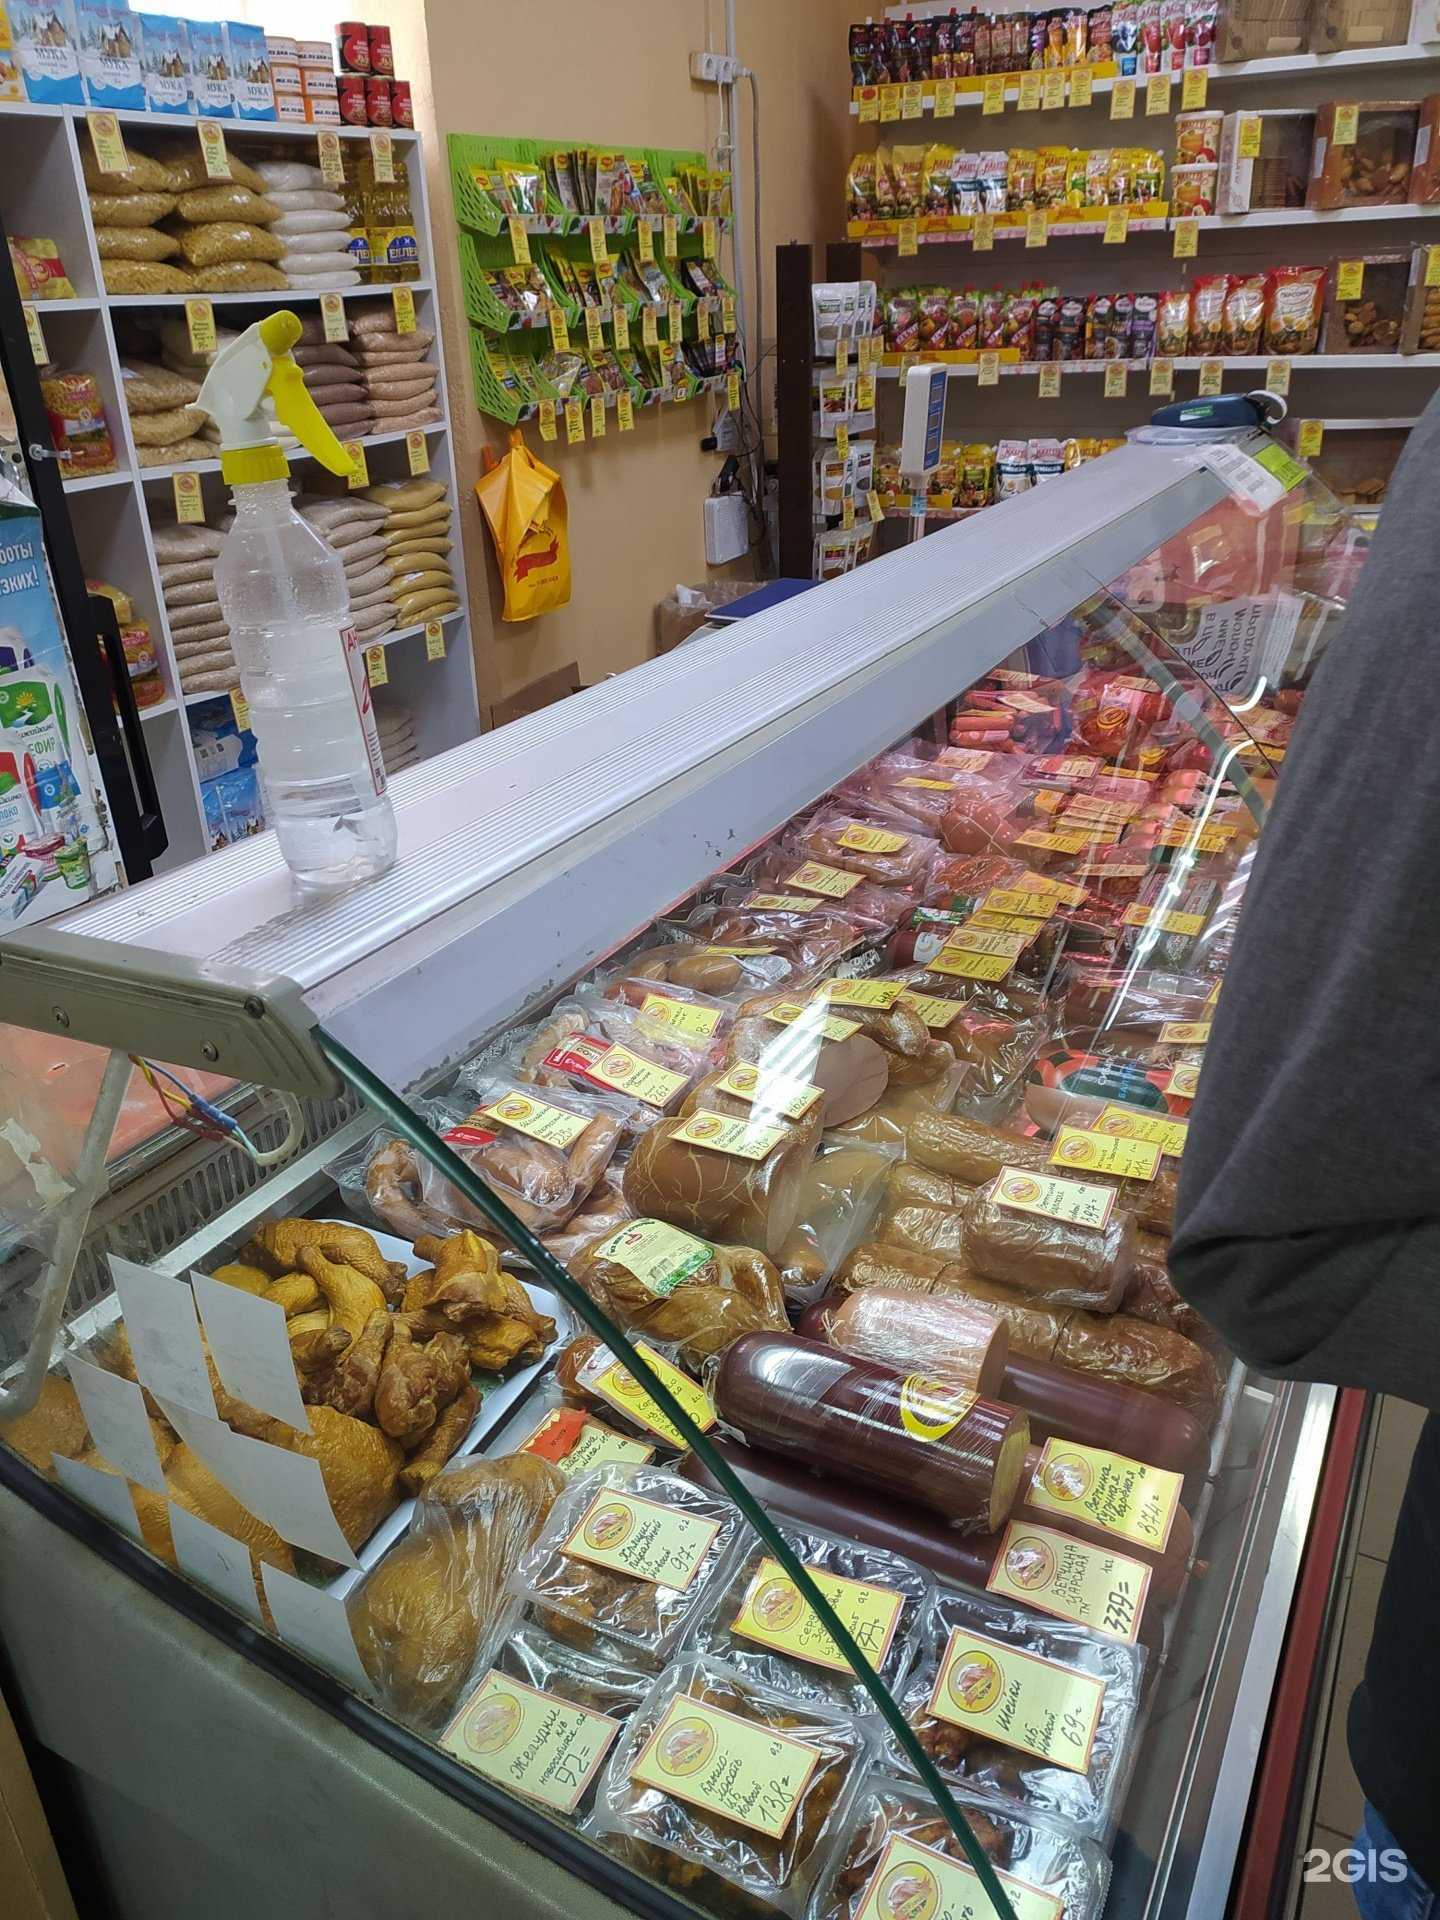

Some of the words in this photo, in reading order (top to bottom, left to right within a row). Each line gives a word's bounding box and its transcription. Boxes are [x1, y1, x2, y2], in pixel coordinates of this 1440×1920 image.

[34, 47, 68, 61] МУКА
[160, 80, 184, 92] МУКА
[206, 83, 228, 94] МУКА
[247, 86, 270, 97] МУКА
[0, 564, 40, 595] ЗКИХ!
[28, 736, 56, 757] ЕФИР
[1051, 1544, 1078, 1598] ВЕТЧИНА
